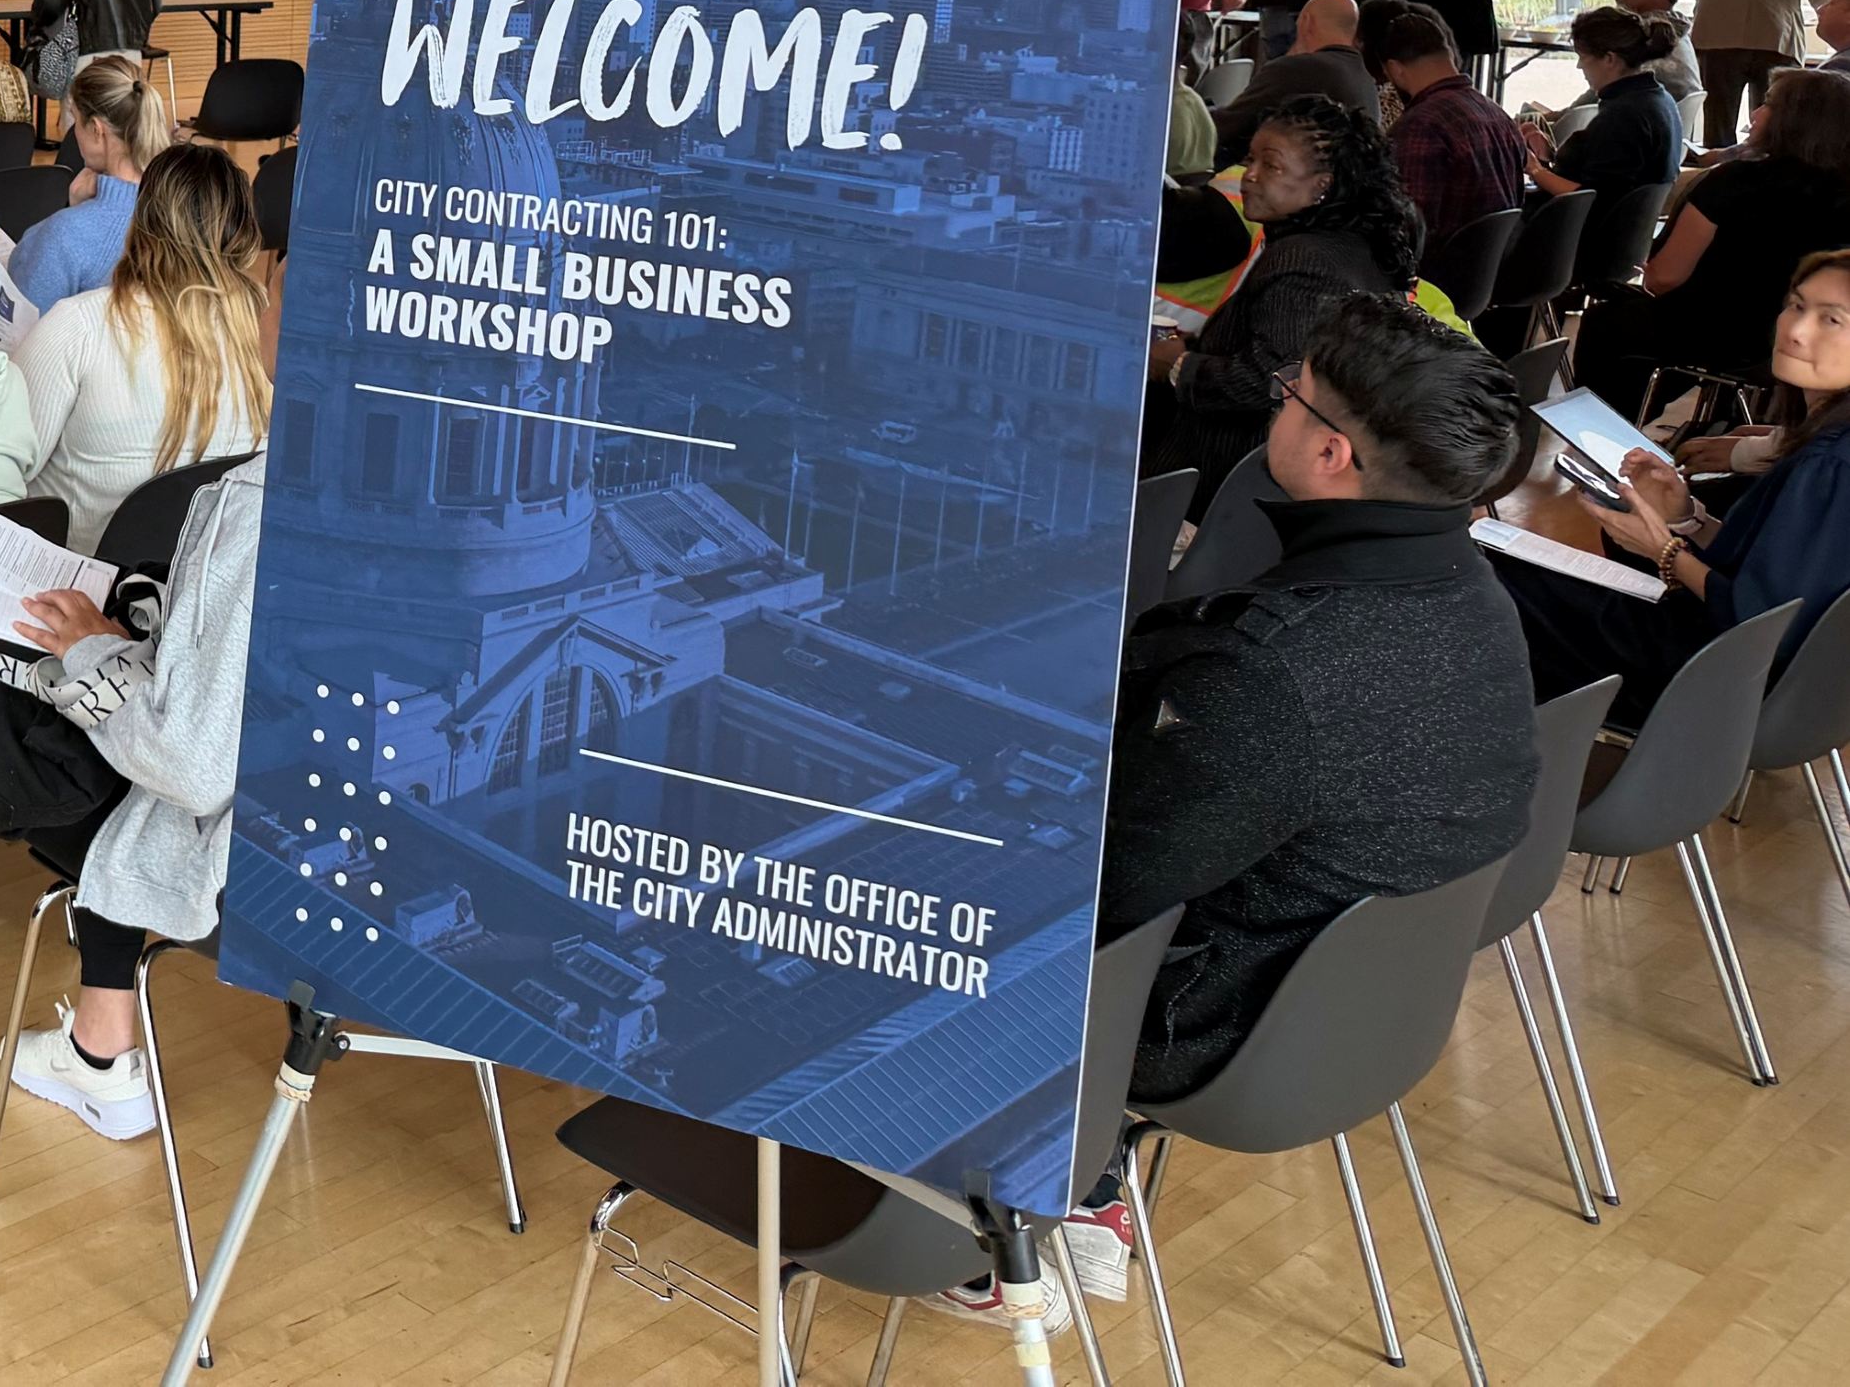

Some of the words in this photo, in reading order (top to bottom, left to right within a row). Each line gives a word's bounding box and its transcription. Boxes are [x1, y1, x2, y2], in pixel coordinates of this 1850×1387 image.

[375, 178, 438, 218] CITY
[445, 186, 653, 244] CONTRACTING
[663, 211, 728, 252] 101:
[366, 285, 613, 364] WORKSHOP
[367, 228, 395, 275] A
[409, 233, 547, 296] SMALL
[561, 251, 792, 328] BUSINESS
[566, 812, 690, 876] HOSTED
[699, 844, 745, 889] BY
[753, 856, 816, 907] THE
[824, 874, 941, 936] OFFICE
[950, 902, 996, 947] OF
[566, 859, 624, 910] THE
[632, 877, 705, 928] CITY
[711, 897, 989, 999] ADMINISTRATOR
